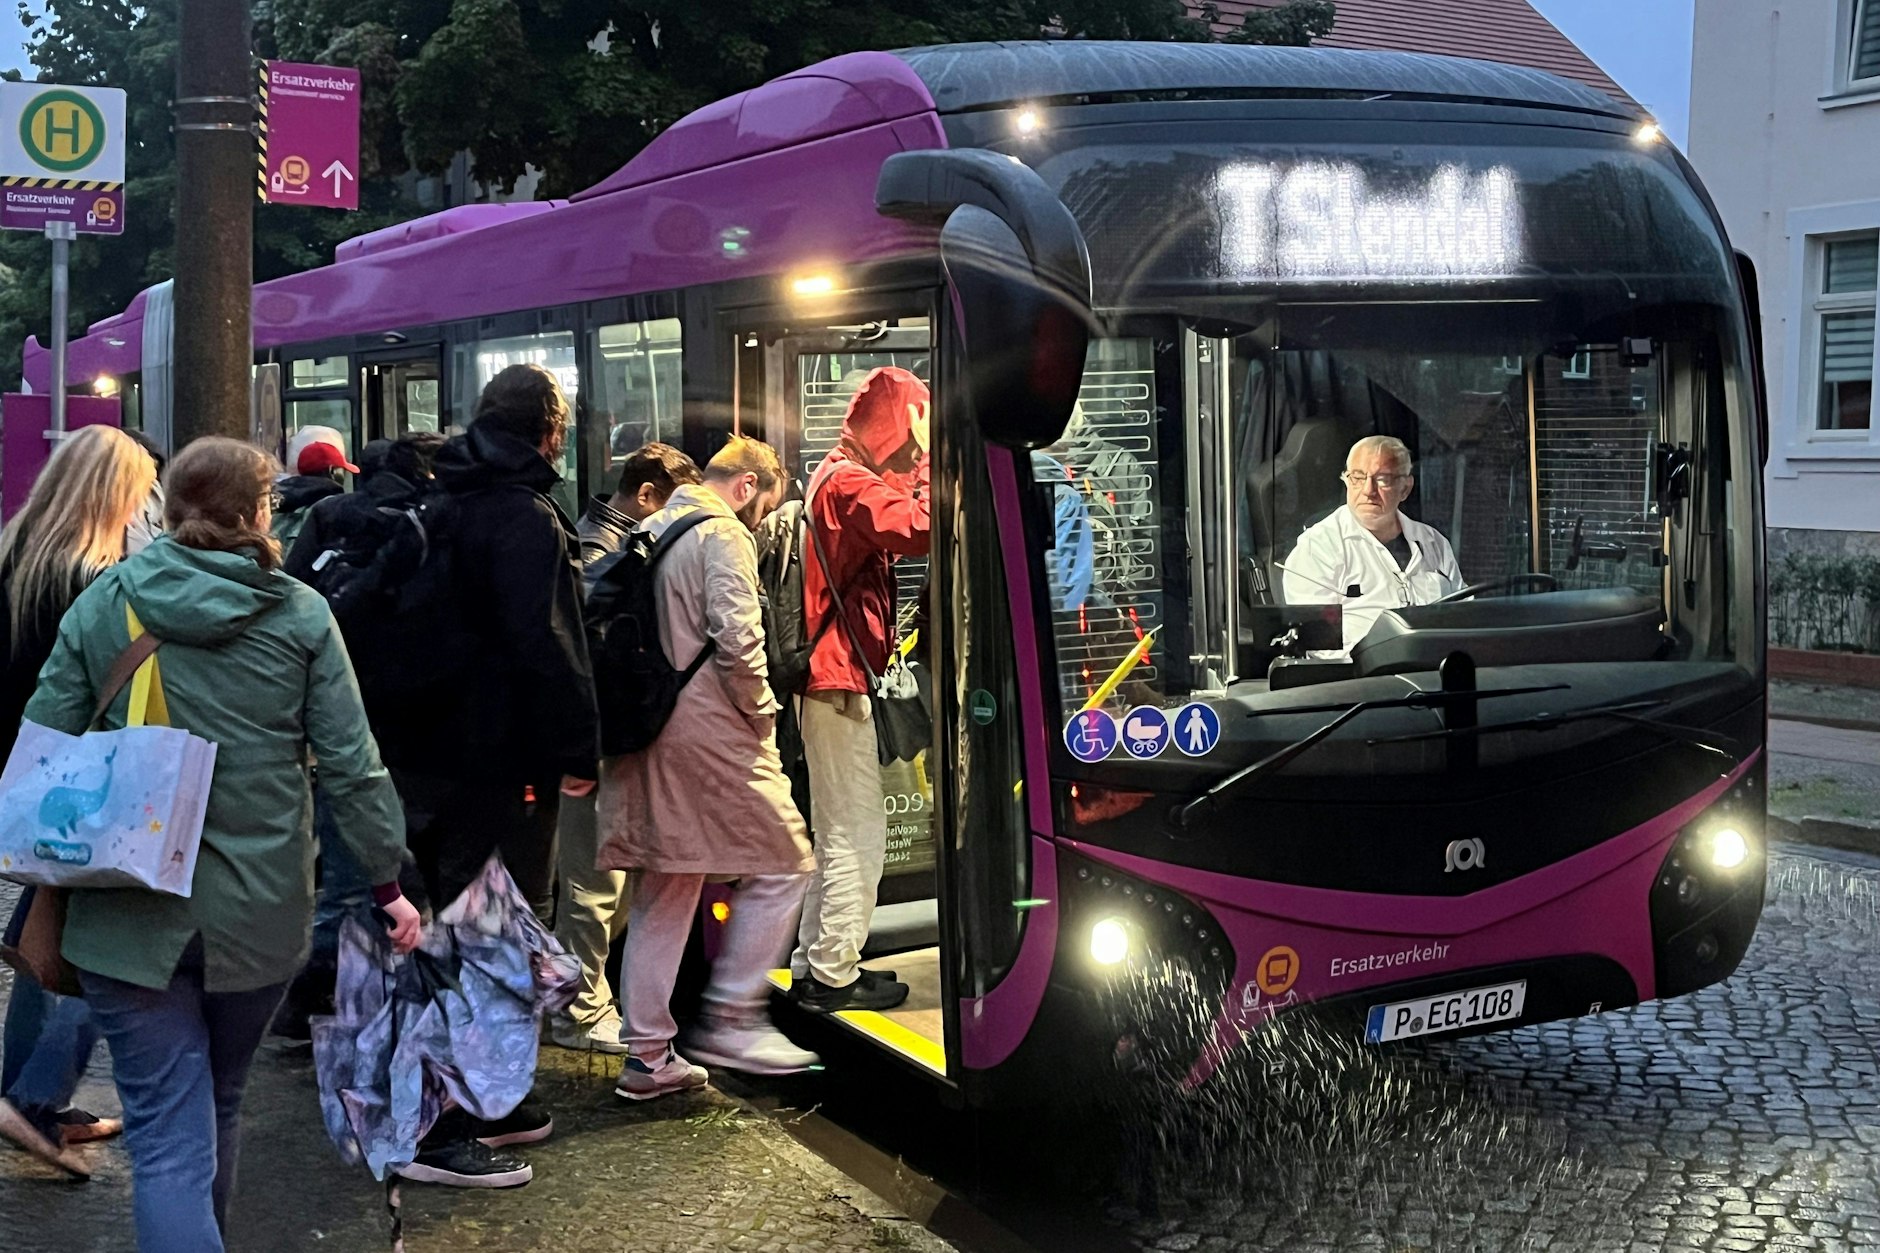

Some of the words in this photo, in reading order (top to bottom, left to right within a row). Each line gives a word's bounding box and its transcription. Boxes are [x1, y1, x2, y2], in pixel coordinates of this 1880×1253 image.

[271, 71, 356, 92] Ersatzverkehr
[45, 107, 80, 154] H
[6, 191, 76, 206] Ersatzverkehr
[1330, 941, 1450, 977] Ersatzverkehr
[1394, 1007, 1412, 1036] P
[1427, 998, 1462, 1029] EG
[1465, 989, 1514, 1023] 108
